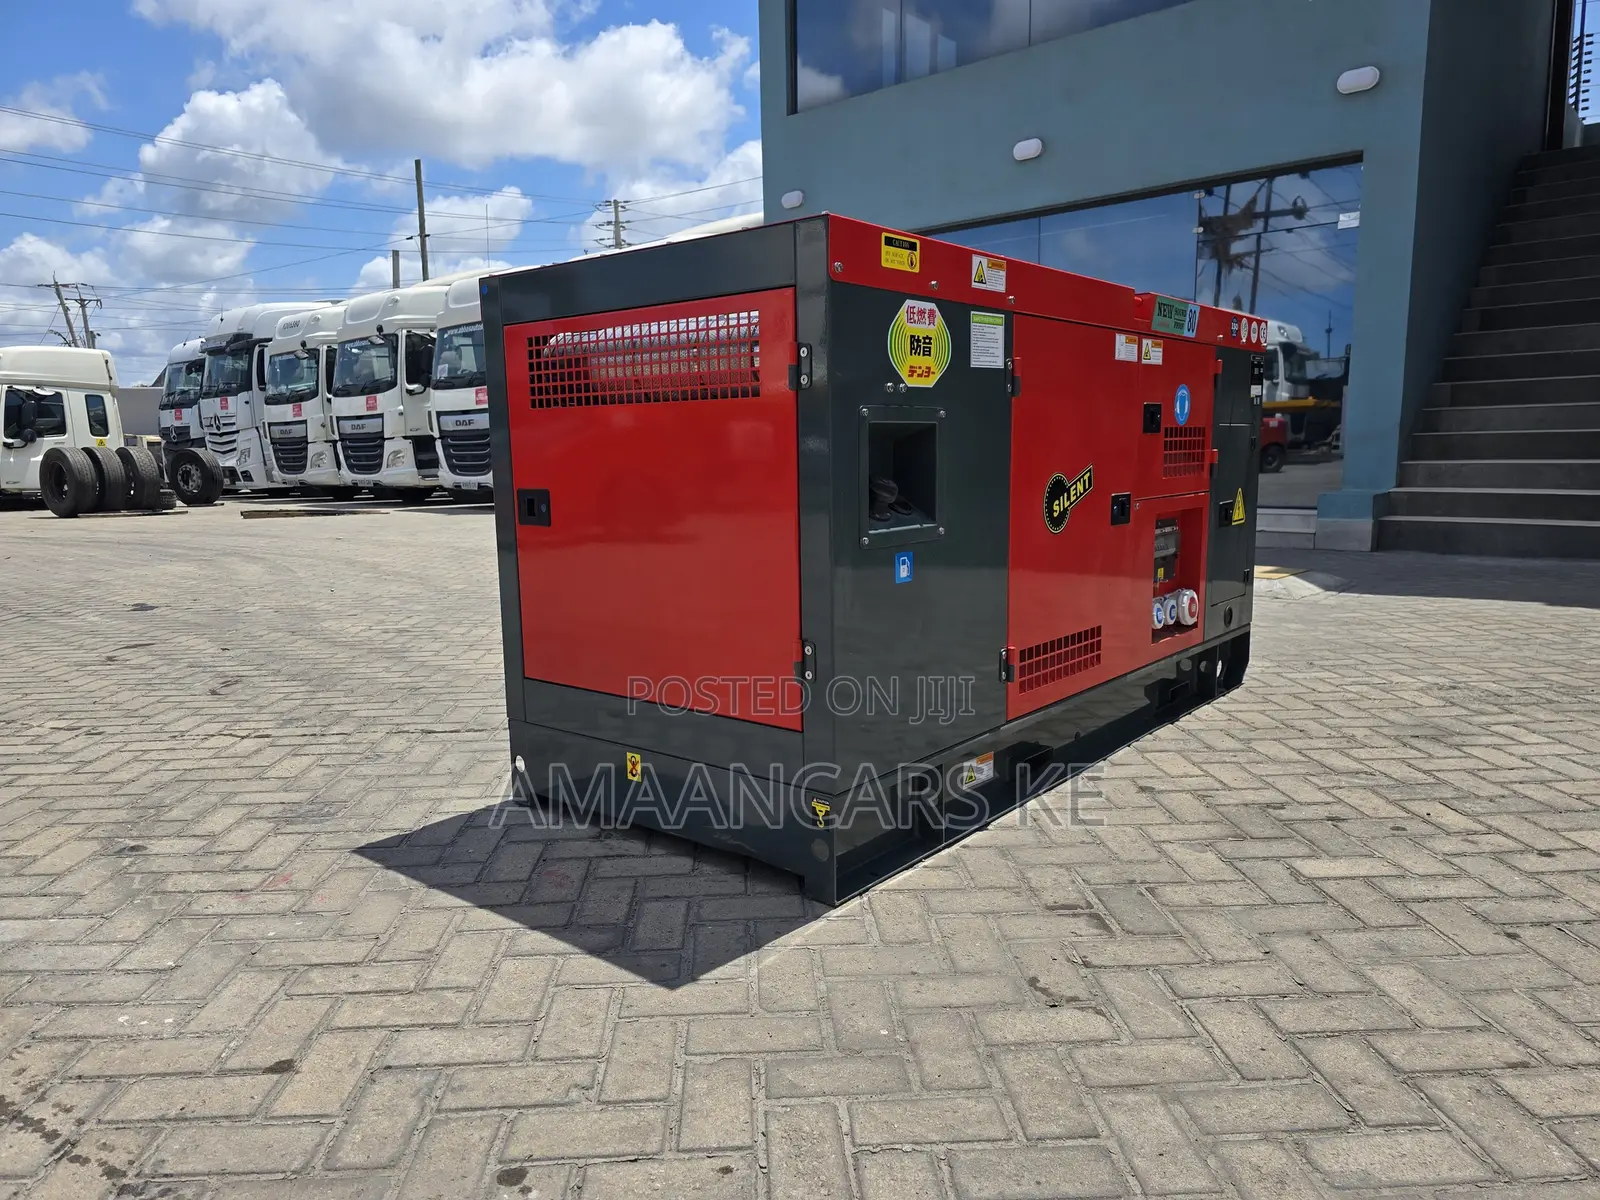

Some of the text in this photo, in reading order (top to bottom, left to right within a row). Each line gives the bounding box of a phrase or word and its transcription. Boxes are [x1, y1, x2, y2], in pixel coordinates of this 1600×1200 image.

[905, 305, 936, 327] 低燃費
[1157, 302, 1175, 320] NEW
[1187, 309, 1197, 333] 80
[1231, 322, 1239, 332] ISO
[909, 335, 933, 357] 防音
[455, 419, 475, 427] DAF
[1053, 472, 1091, 518] SILENT
